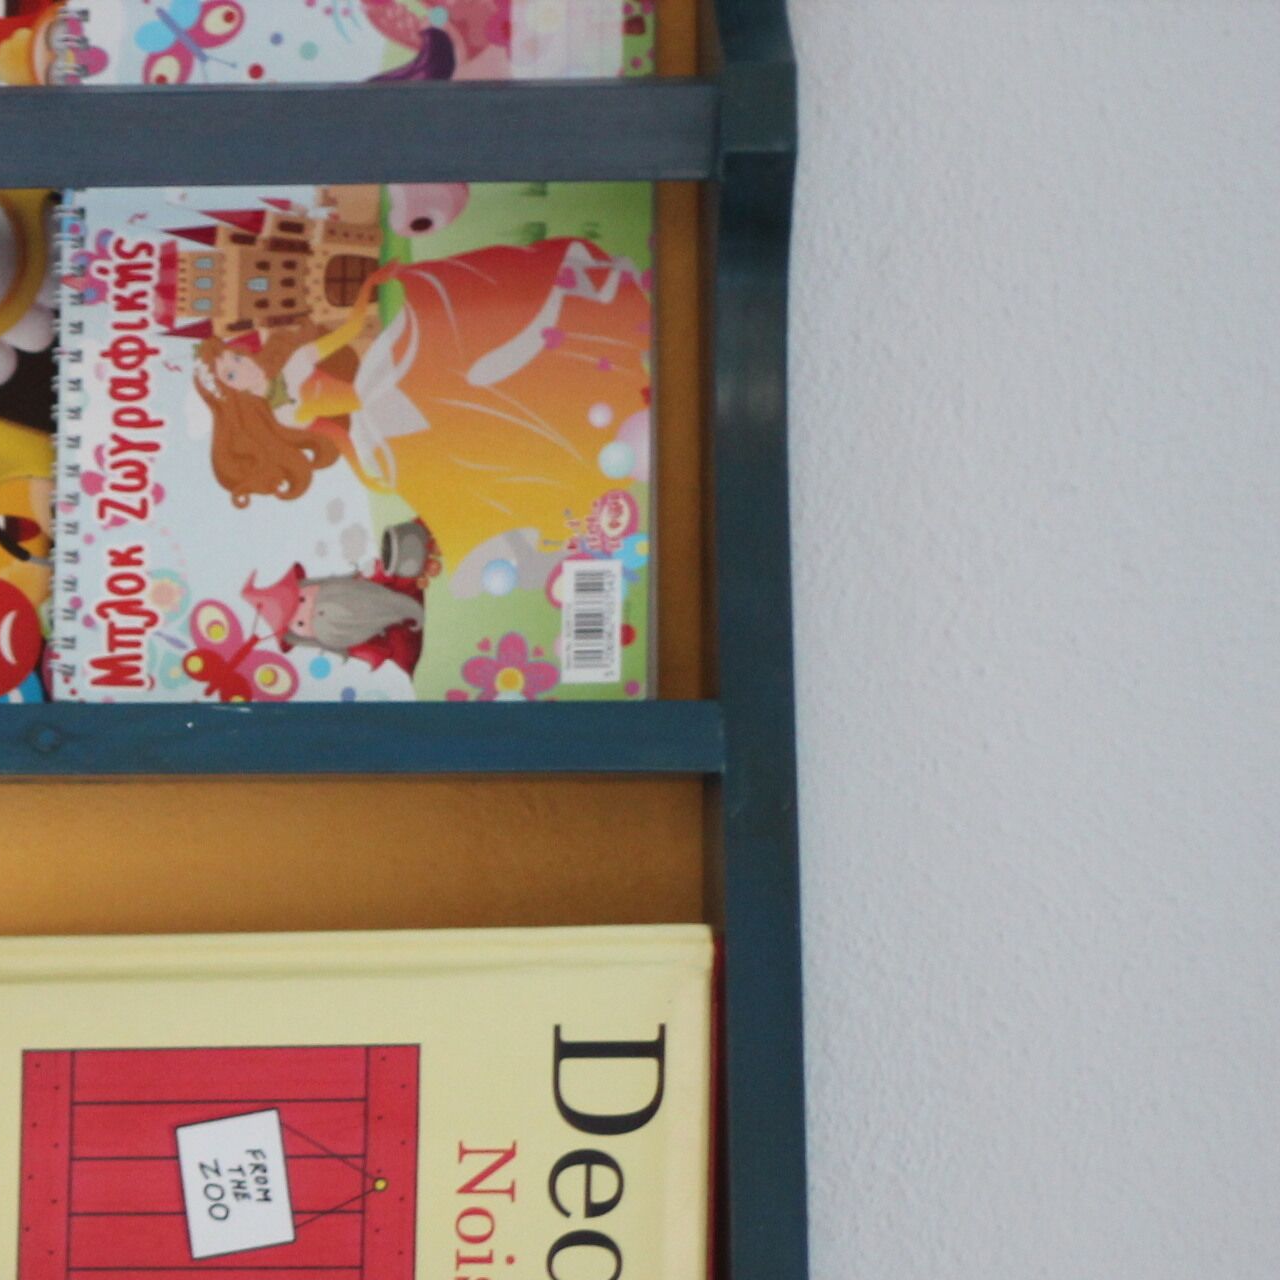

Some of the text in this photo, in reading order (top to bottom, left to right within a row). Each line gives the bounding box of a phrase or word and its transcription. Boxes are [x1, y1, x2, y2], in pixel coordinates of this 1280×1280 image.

[91, 236, 164, 690] Μπλοκ Ζωγραφικής
[198, 1159, 230, 1221] ZOO
[227, 1165, 251, 1202] THE
[245, 1148, 272, 1202] FROM
